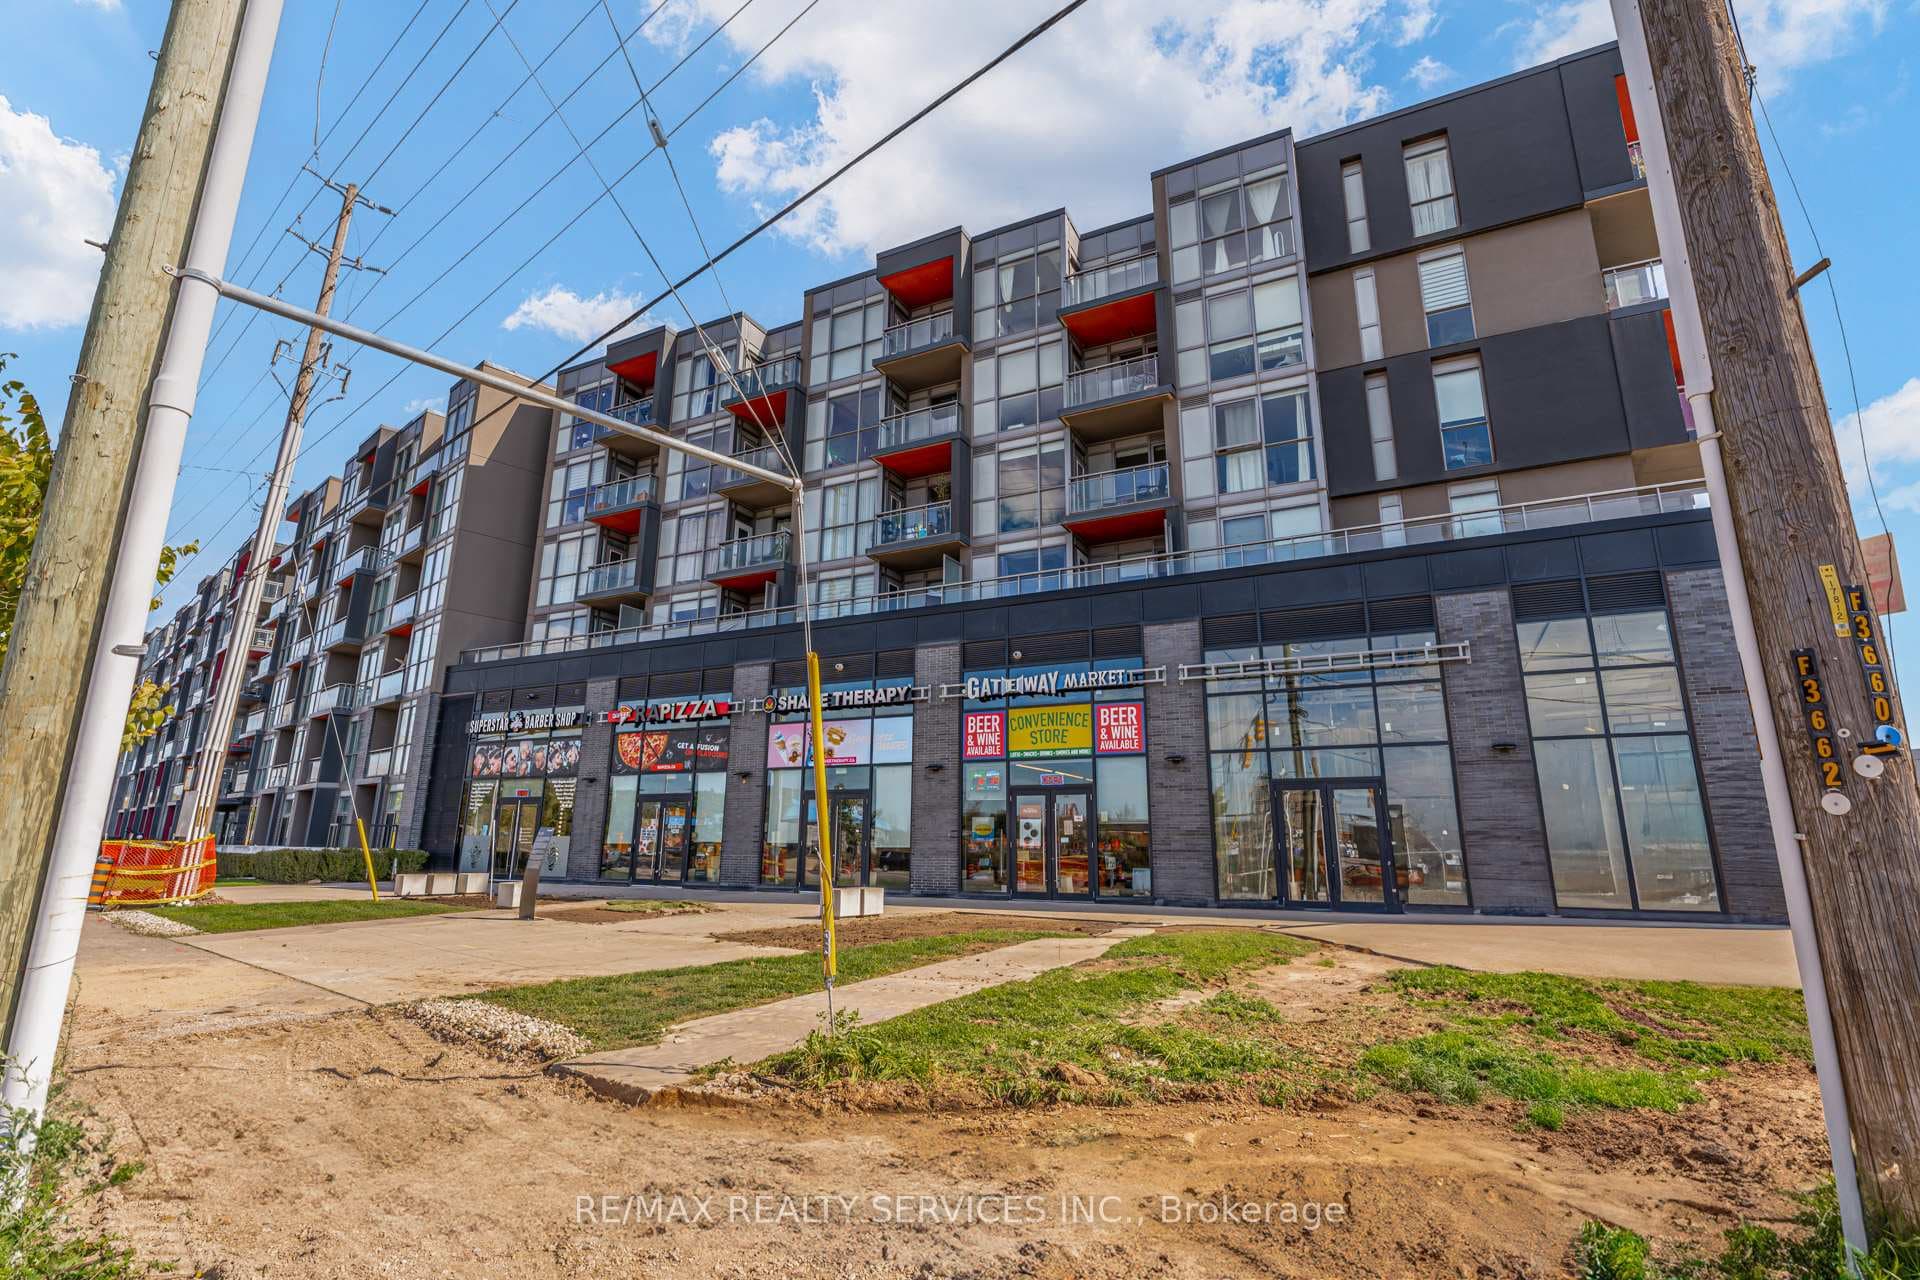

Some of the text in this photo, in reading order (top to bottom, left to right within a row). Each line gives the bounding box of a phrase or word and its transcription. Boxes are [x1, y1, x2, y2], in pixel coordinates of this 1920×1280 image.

[1849, 591, 1890, 722] F3660
[967, 669, 1125, 700] GATEWAY MARKET
[778, 687, 907, 711] SHAE THERAPY
[469, 711, 577, 733] SUPERSTAR BARBER SHOP
[967, 715, 1000, 733] BEER
[1010, 712, 1089, 731] CONVENIENCE
[1100, 706, 1138, 726] BEER
[1797, 656, 1841, 786] F3662
[967, 733, 1000, 746] & WINE
[1030, 729, 1068, 745] STORE
[1100, 725, 1139, 740] & WINE
[967, 745, 1001, 756] AVAILABLE
[1100, 739, 1139, 750] AVAILABLE
